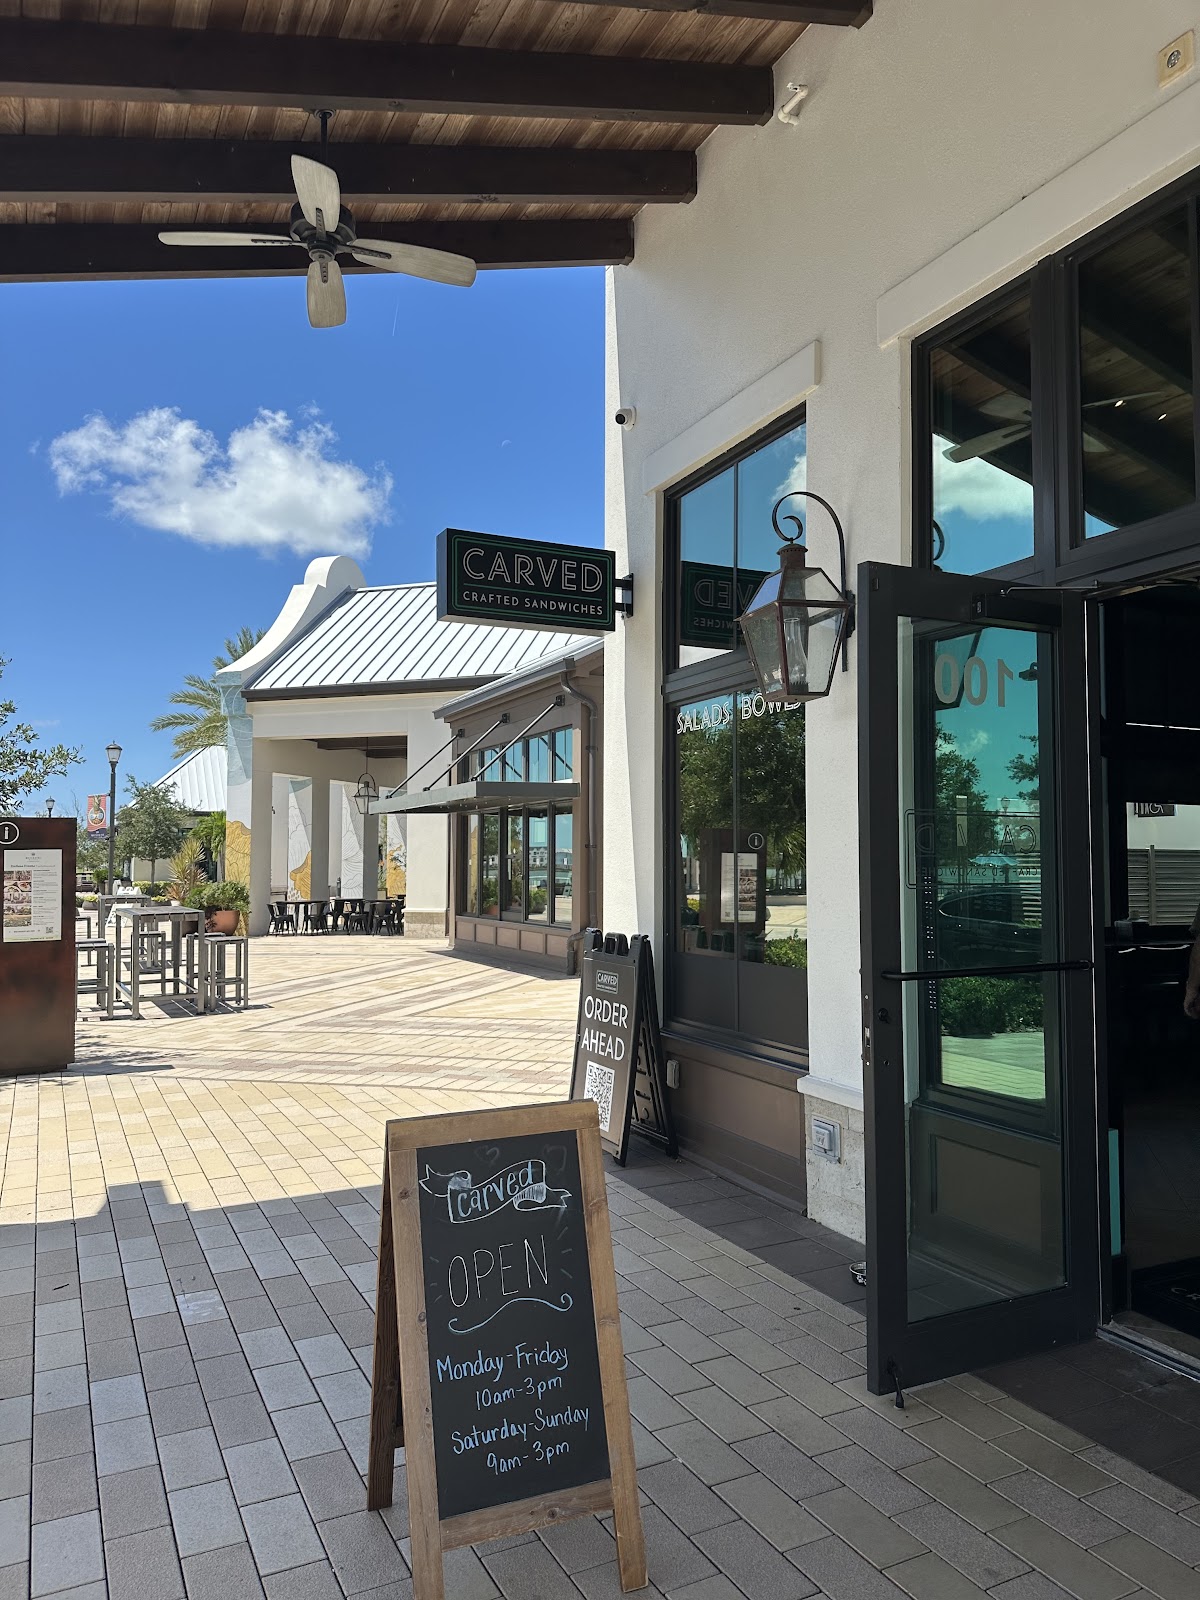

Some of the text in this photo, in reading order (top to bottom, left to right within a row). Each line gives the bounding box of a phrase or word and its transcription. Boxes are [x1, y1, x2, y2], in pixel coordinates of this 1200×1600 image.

[463, 548, 603, 592] CARVED
[463, 591, 603, 615] CRAFTED SANDWICHES
[676, 701, 730, 735] SALADS
[597, 972, 617, 985] CARVED
[584, 996, 628, 1029] ORDER
[581, 1027, 625, 1061] AHEAD
[449, 1235, 548, 1307] OPEN
